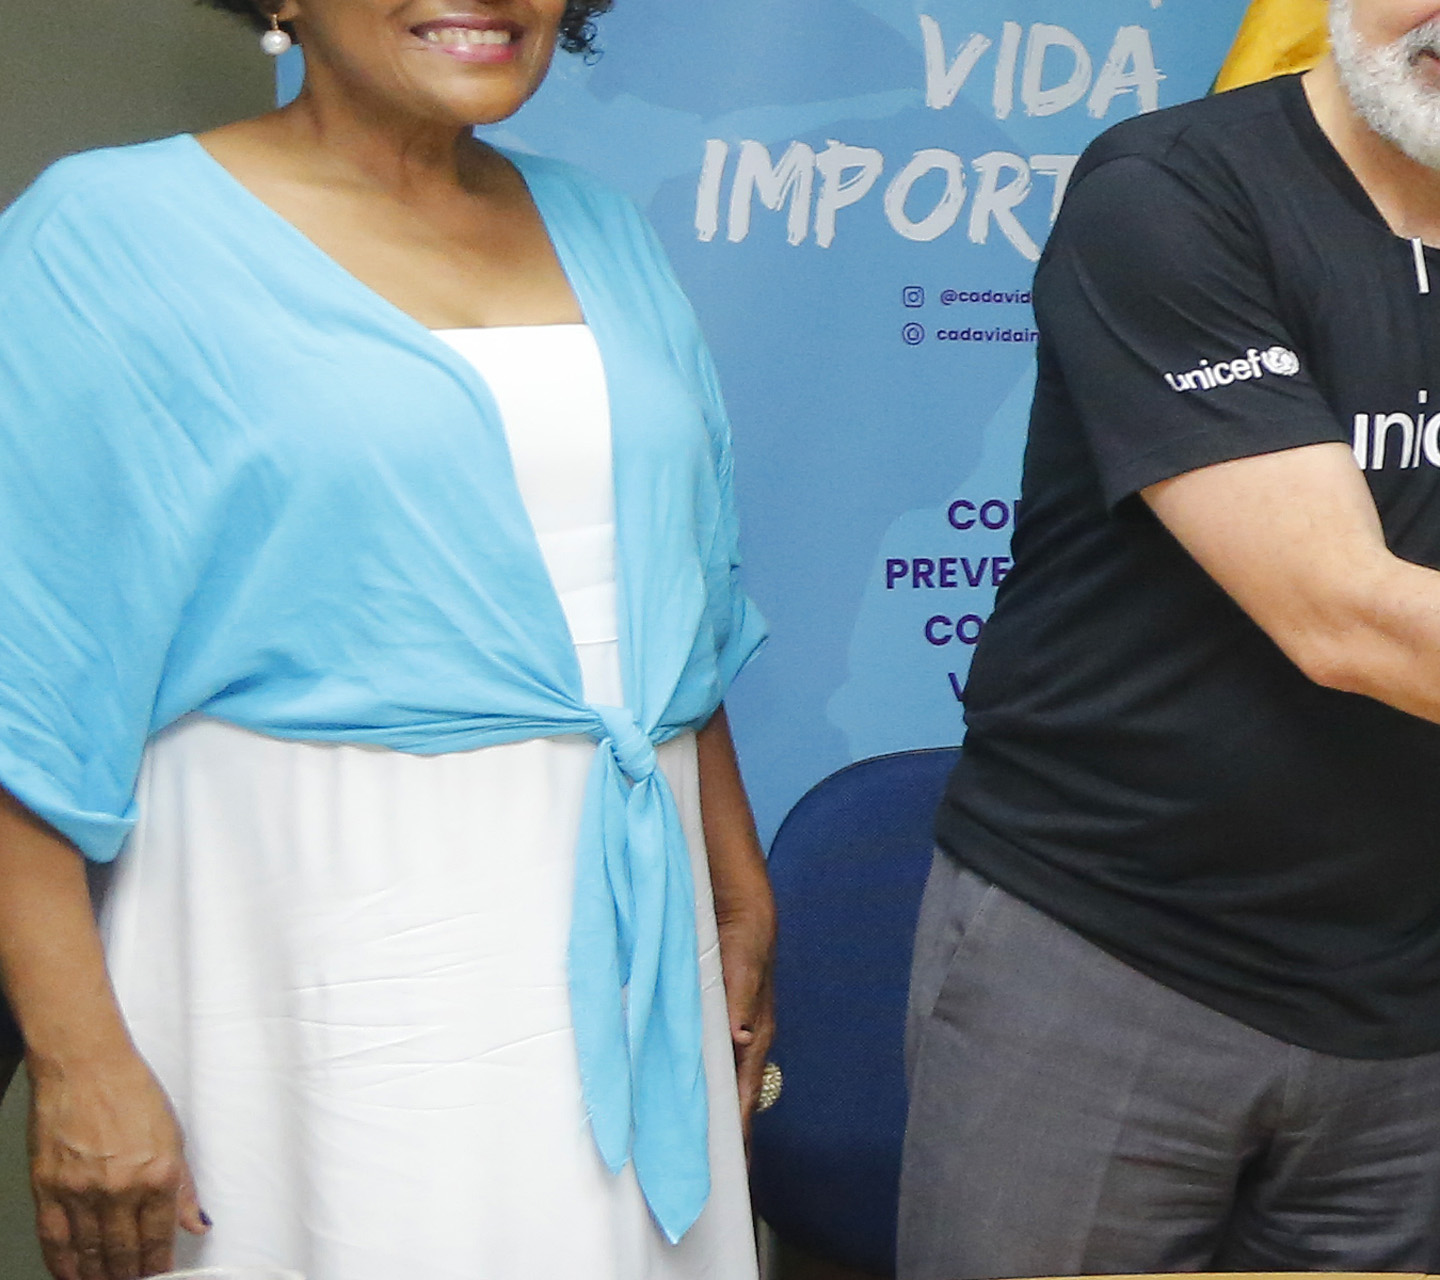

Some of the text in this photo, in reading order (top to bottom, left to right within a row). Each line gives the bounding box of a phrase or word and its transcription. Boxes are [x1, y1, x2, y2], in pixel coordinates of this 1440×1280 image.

[918, 14, 1168, 120] VIDA
[694, 137, 1081, 263] IMPORT
[940, 289, 1034, 306] @cadavid
[1164, 347, 1263, 394] unicef
[948, 499, 1023, 531] CO
[886, 556, 1011, 589] PREVE
[925, 614, 985, 646] CO
